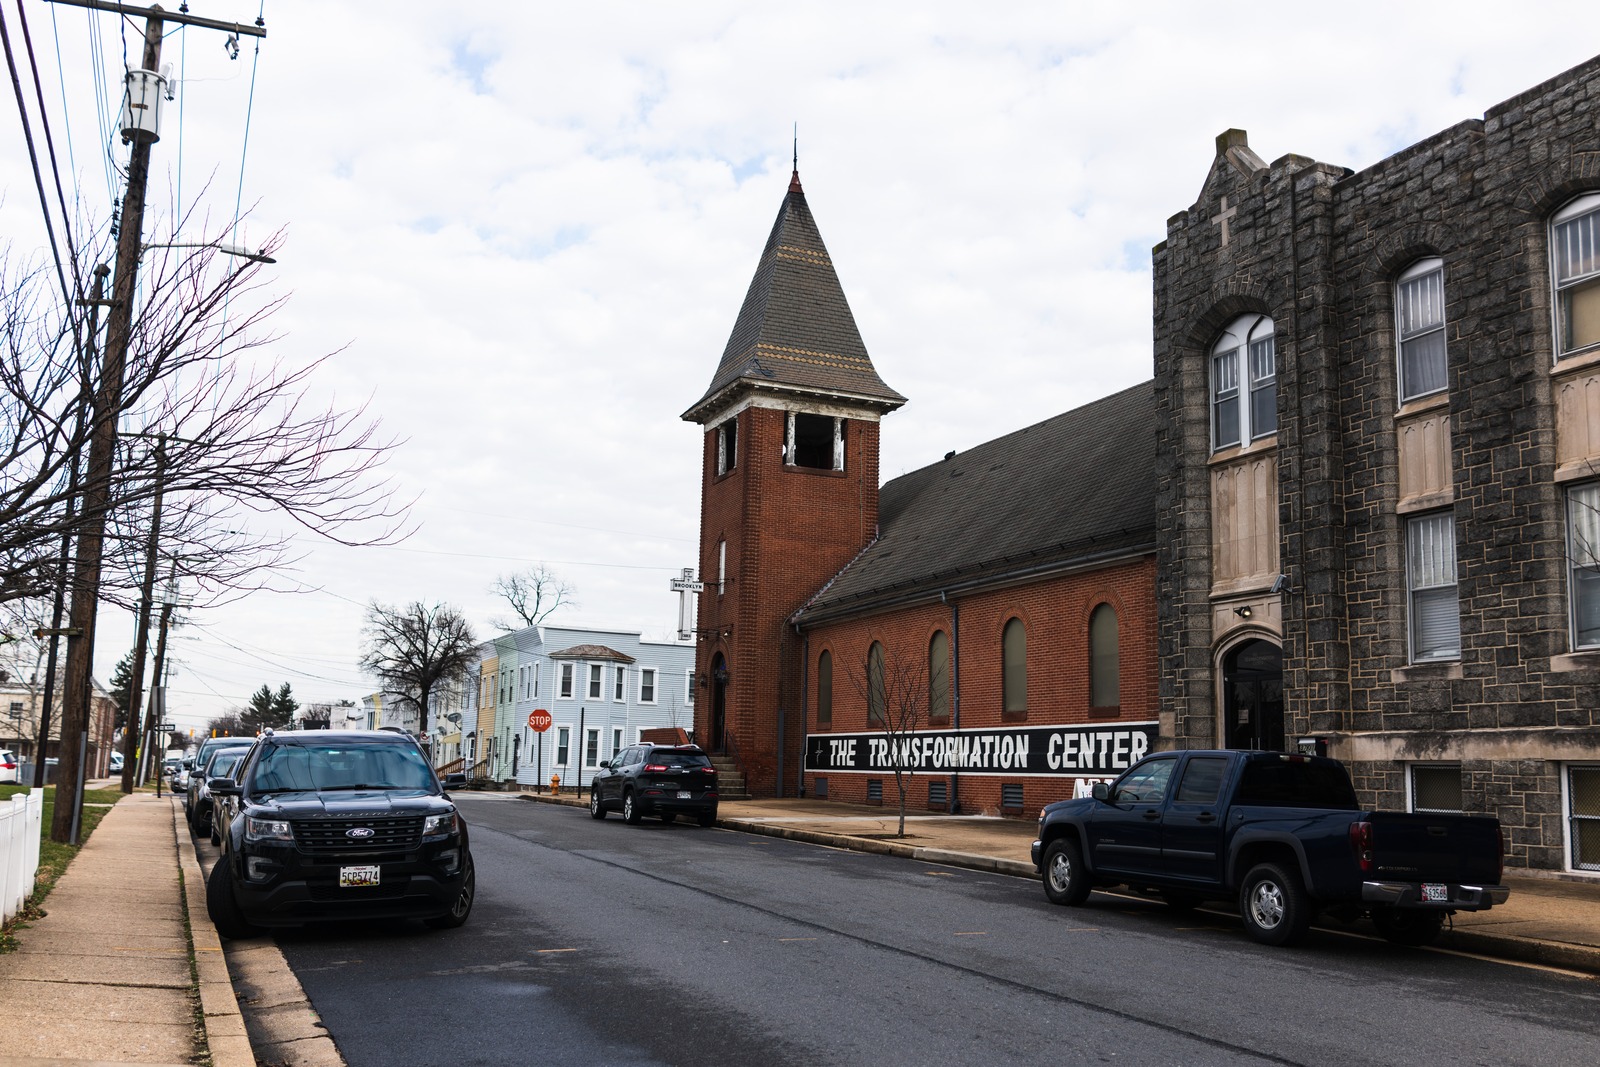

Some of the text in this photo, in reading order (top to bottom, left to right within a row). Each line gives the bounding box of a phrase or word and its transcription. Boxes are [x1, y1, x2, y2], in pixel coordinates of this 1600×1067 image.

[530, 716, 551, 725] STOP
[829, 730, 1148, 770] THE TRANSFORMATION CENTER
[352, 829, 369, 837] Ford
[342, 871, 378, 883] 5CP5774
